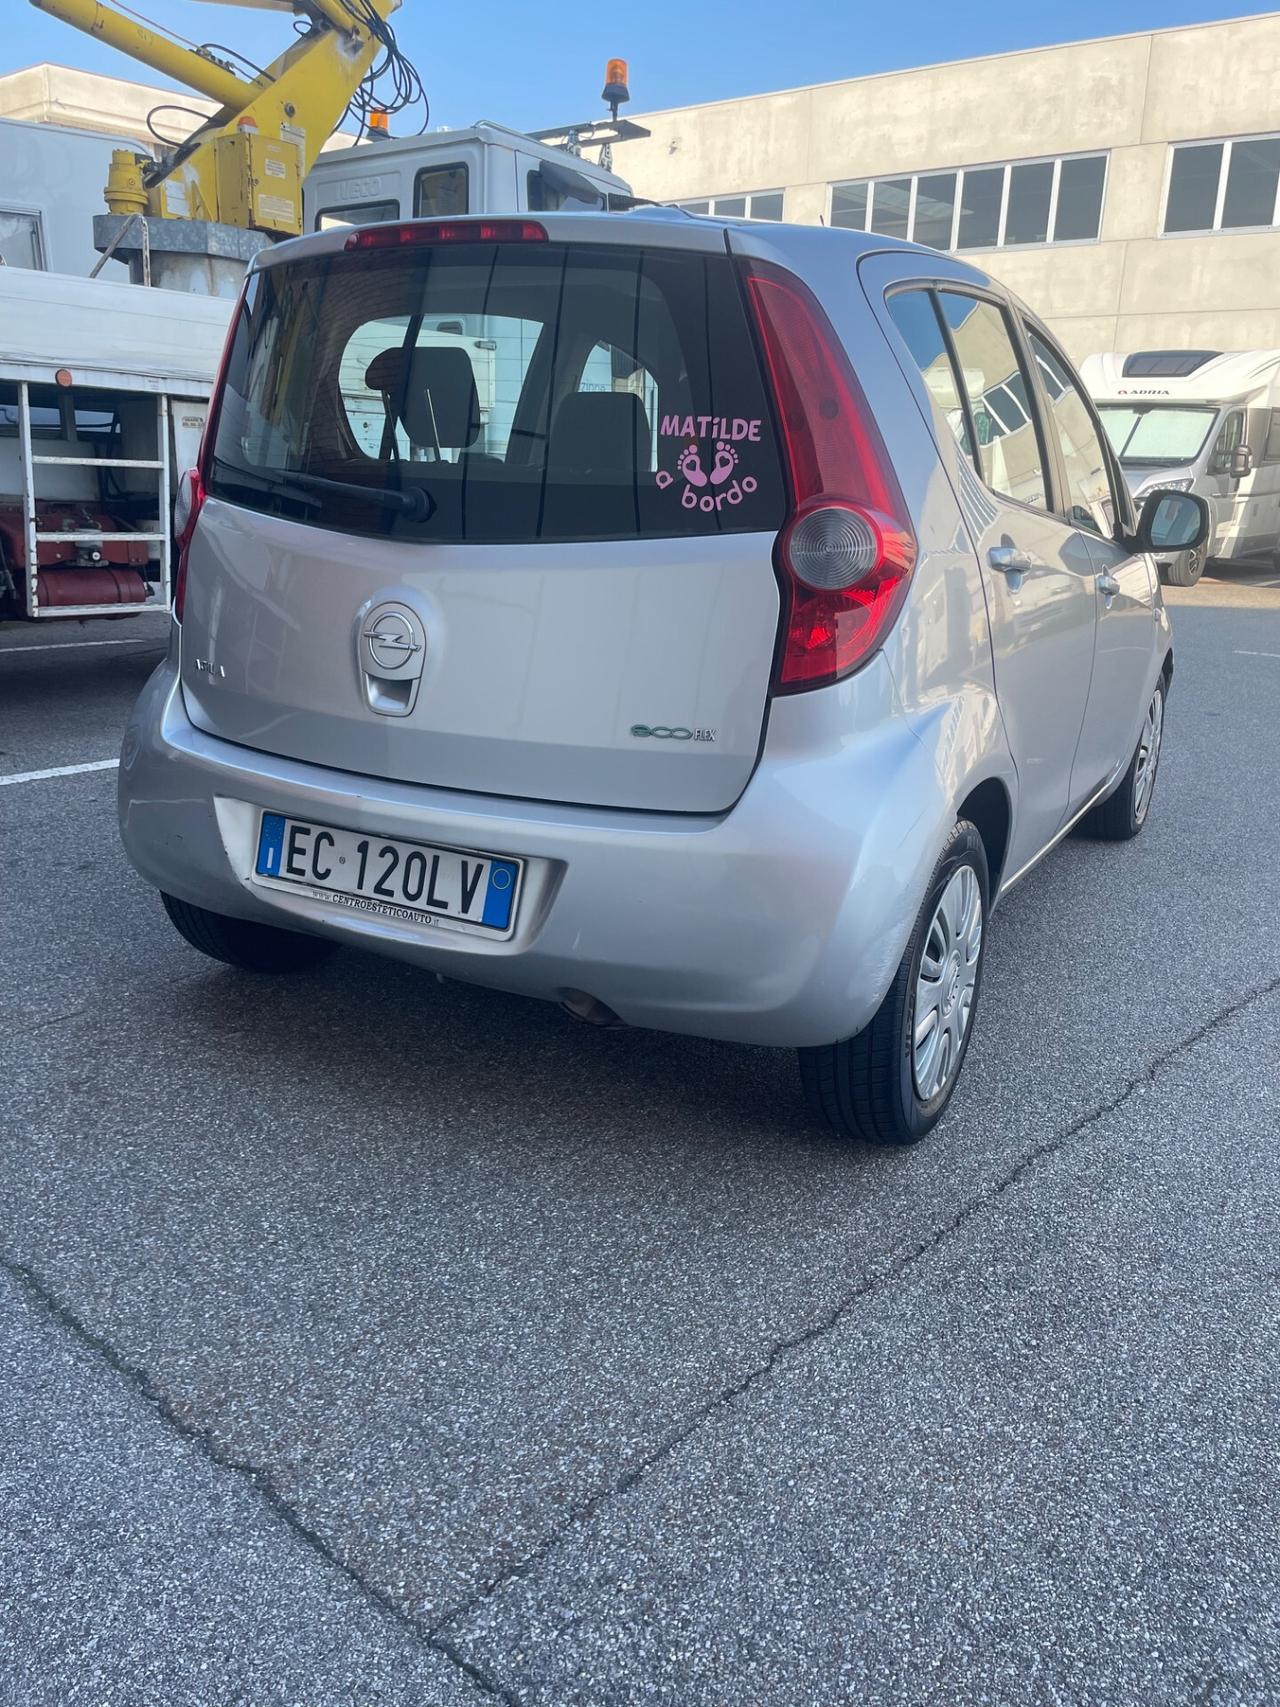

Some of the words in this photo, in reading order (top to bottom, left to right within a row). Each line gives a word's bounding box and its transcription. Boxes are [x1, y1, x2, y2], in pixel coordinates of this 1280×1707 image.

[655, 470, 673, 490] a
[681, 476, 757, 512] bordo
[266, 847, 274, 869] I
[286, 825, 335, 880] EC
